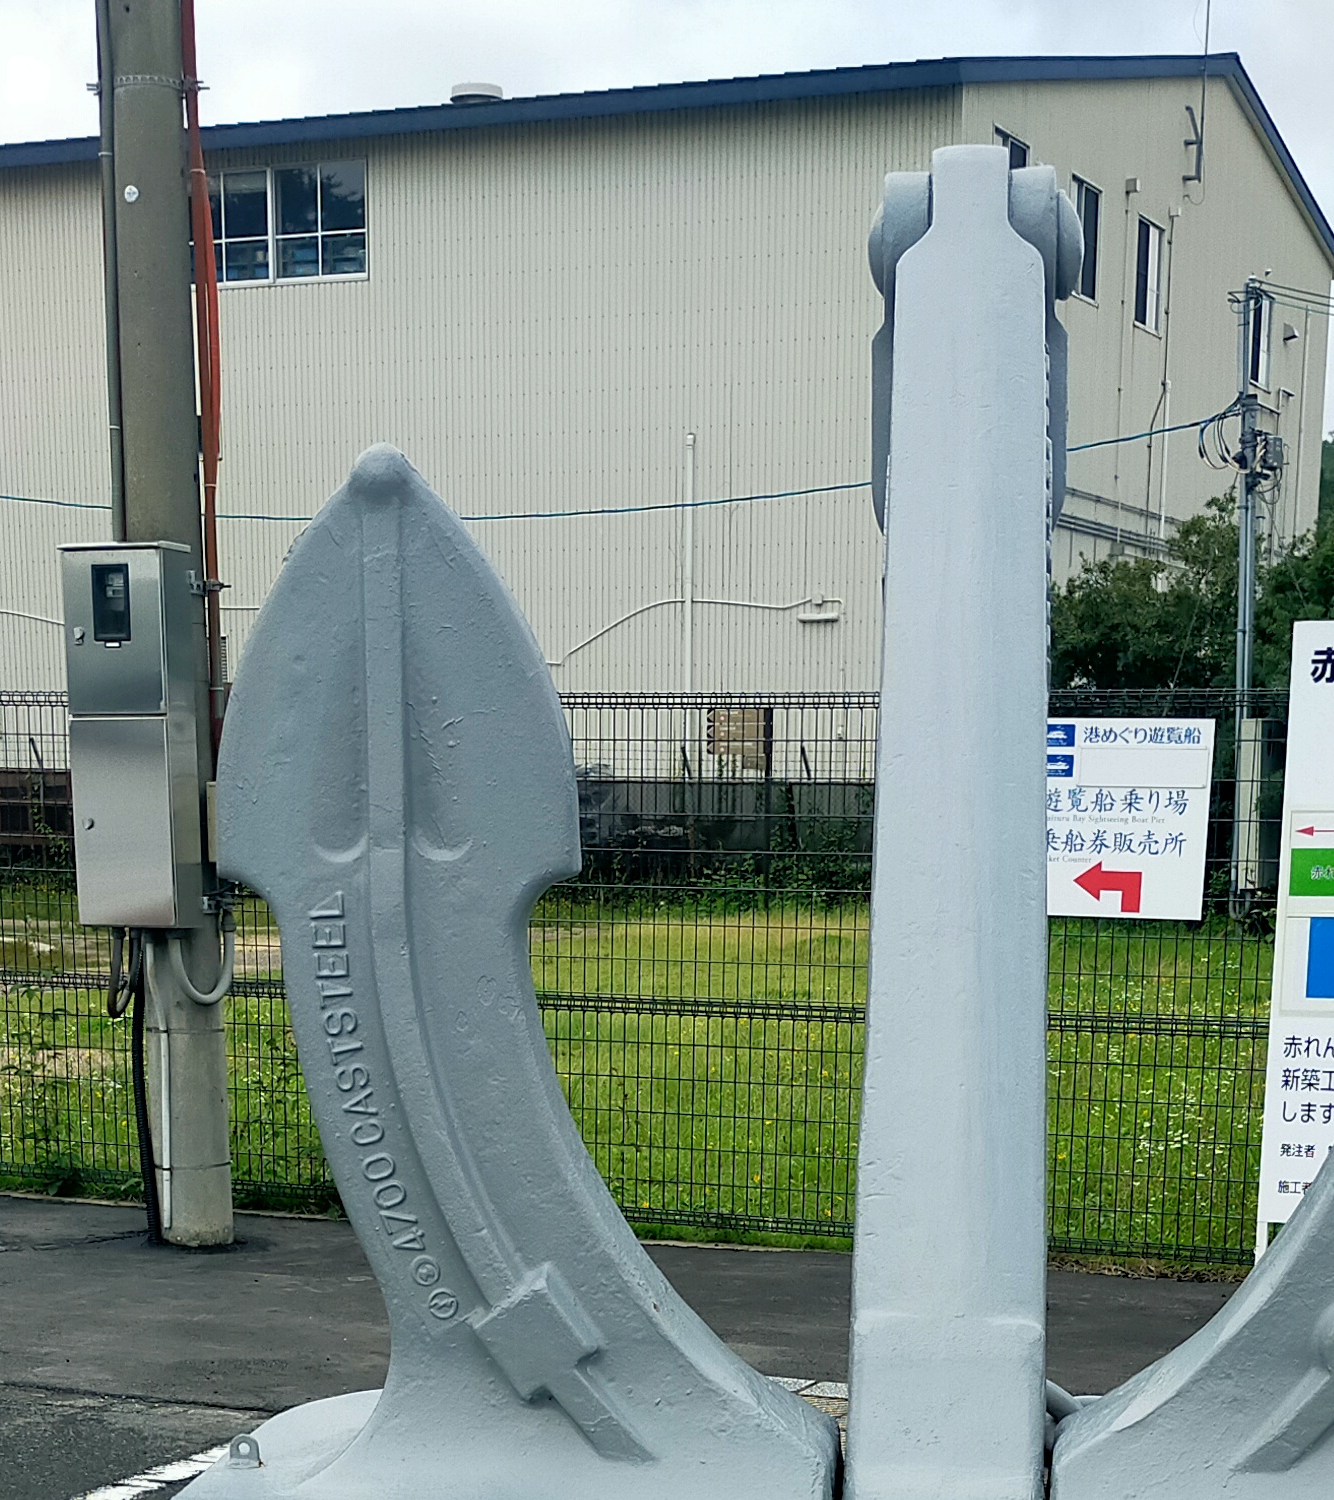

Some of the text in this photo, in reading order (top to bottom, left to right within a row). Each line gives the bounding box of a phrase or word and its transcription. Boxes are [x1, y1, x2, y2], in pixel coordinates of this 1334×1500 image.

[1083, 726, 1202, 744] 港めぐり遊覧船
[1047, 787, 1189, 816] 遊覧船乗り場
[1073, 815, 1085, 823] Bay
[1280, 1143, 1315, 1158] 発注者
